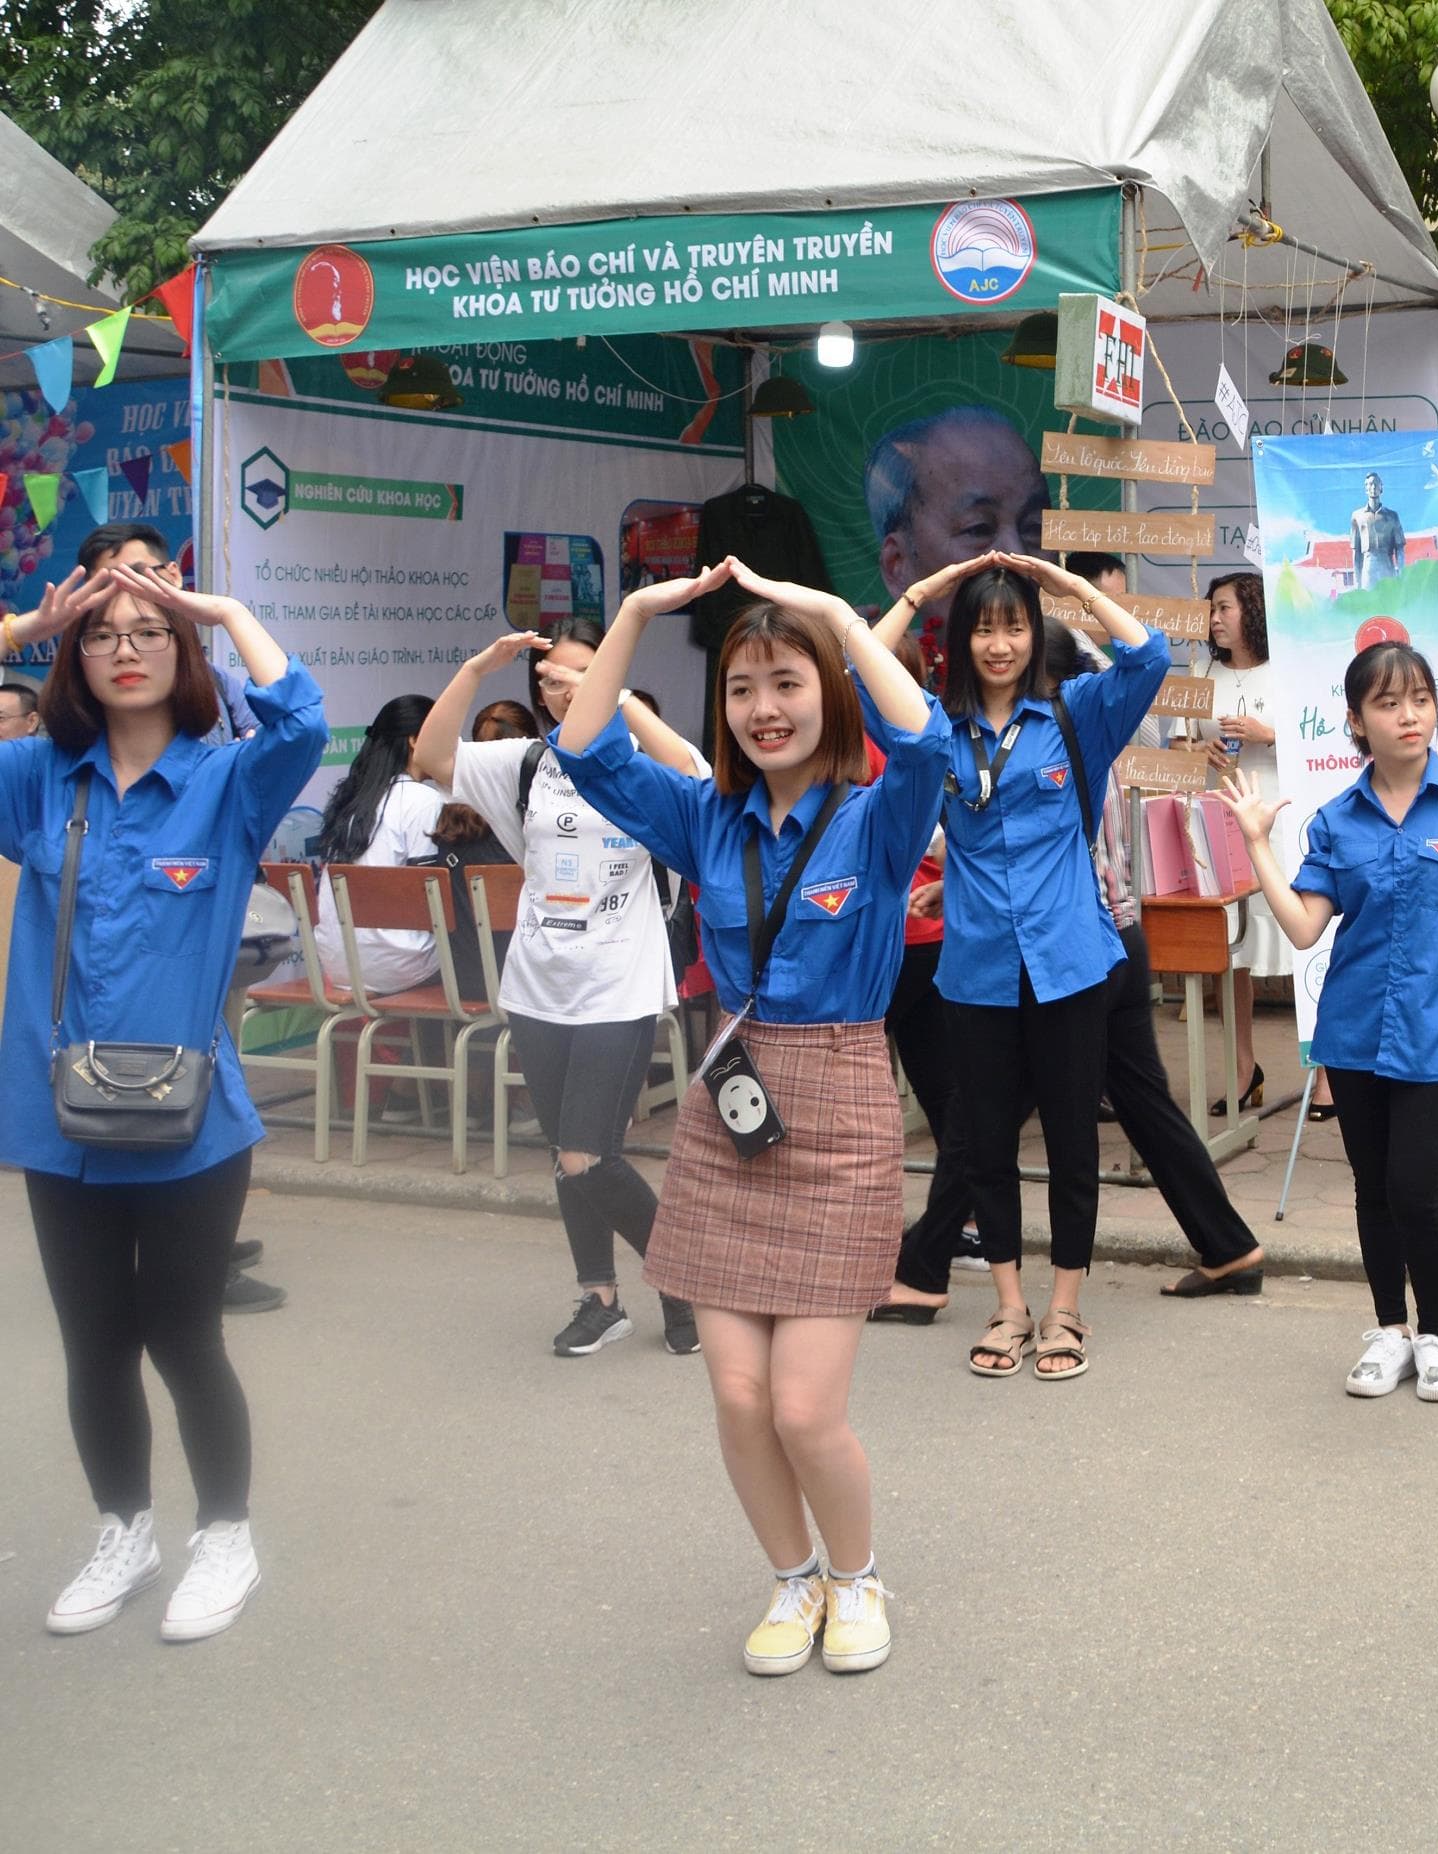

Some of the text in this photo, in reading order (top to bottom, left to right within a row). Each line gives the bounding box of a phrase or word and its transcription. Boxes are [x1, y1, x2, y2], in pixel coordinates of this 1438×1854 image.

[405, 263, 461, 295] HỌC
[465, 254, 521, 290] VIỆN
[527, 249, 581, 281] BÁO
[587, 243, 636, 276] CHÍ
[643, 240, 681, 272] VÀ
[687, 233, 785, 268] TRUYÊN
[793, 220, 894, 261] TRUYỀN
[453, 267, 839, 318] KHOA TƯ TƯỞNG HỒ CHÍ MINH
[968, 278, 1000, 293] AJC
[476, 342, 528, 366] ĐỘNG
[480, 368, 501, 390] TƯ
[503, 368, 561, 398] TƯỞNG
[565, 373, 589, 402] HỒ
[594, 383, 622, 408] CHÍ
[626, 389, 665, 412] MINH
[121, 402, 165, 436] HỌC
[1178, 417, 1231, 442] ĐÀO
[1330, 414, 1396, 435] NHÂN
[294, 482, 442, 512] NGHIÊN CỨU KHOA HỌC
[255, 558, 470, 588] TỔ CHỨC NHIỀU HỘI THẢO KHOA HỌC
[282, 605, 317, 621] THAM
[320, 605, 342, 621] GIA
[344, 601, 359, 621] ĐỀ
[362, 603, 379, 621] TÀI
[382, 607, 413, 621] KHOA
[416, 607, 442, 623] HỌC
[446, 604, 471, 622] CÁC
[474, 603, 498, 622] CẤP
[330, 647, 355, 666] BẢN
[359, 647, 388, 665] GIÁO
[428, 647, 444, 664] TÀI
[1299, 706, 1336, 741] Hồ
[1306, 755, 1361, 772] THÔNG
